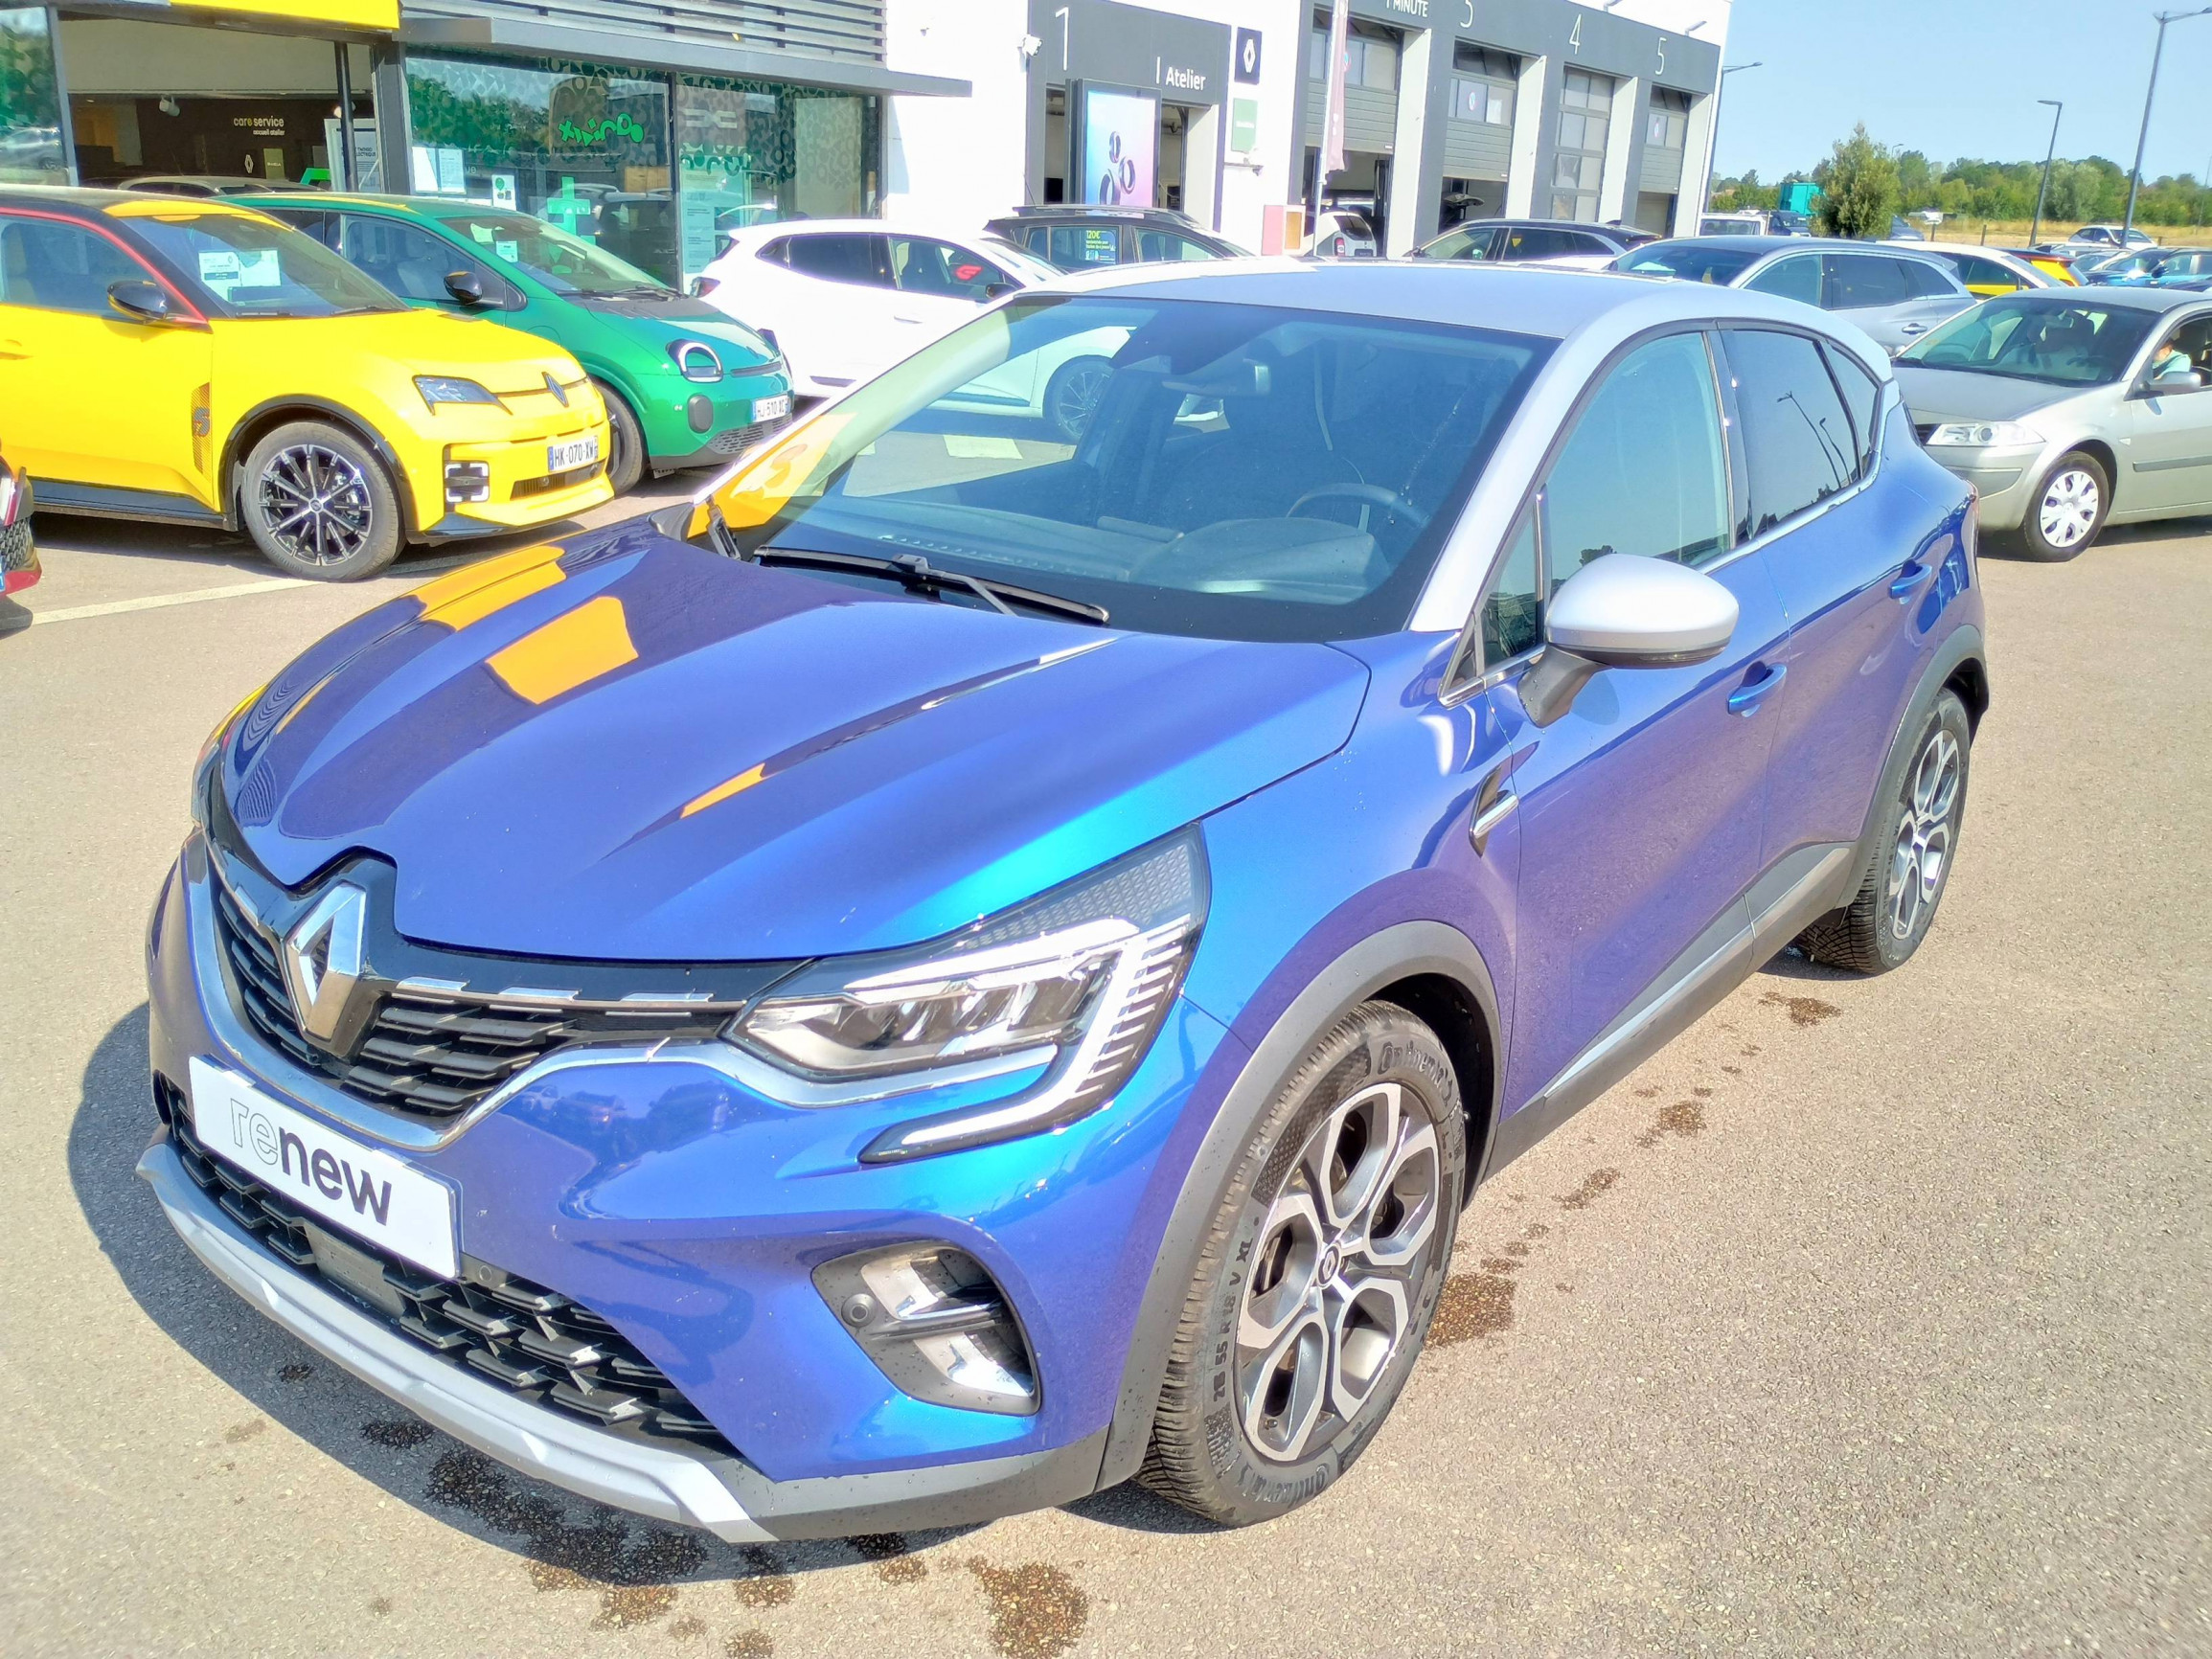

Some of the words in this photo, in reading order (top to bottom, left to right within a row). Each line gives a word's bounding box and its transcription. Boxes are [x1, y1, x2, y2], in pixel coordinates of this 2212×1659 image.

[1055, 7, 1069, 71] 1
[1569, 13, 1582, 55] 4
[1654, 37, 1667, 76] 5
[1165, 66, 1206, 91] Atelier
[233, 117, 253, 126] care
[253, 115, 285, 127] service
[230, 1098, 392, 1226] renew
